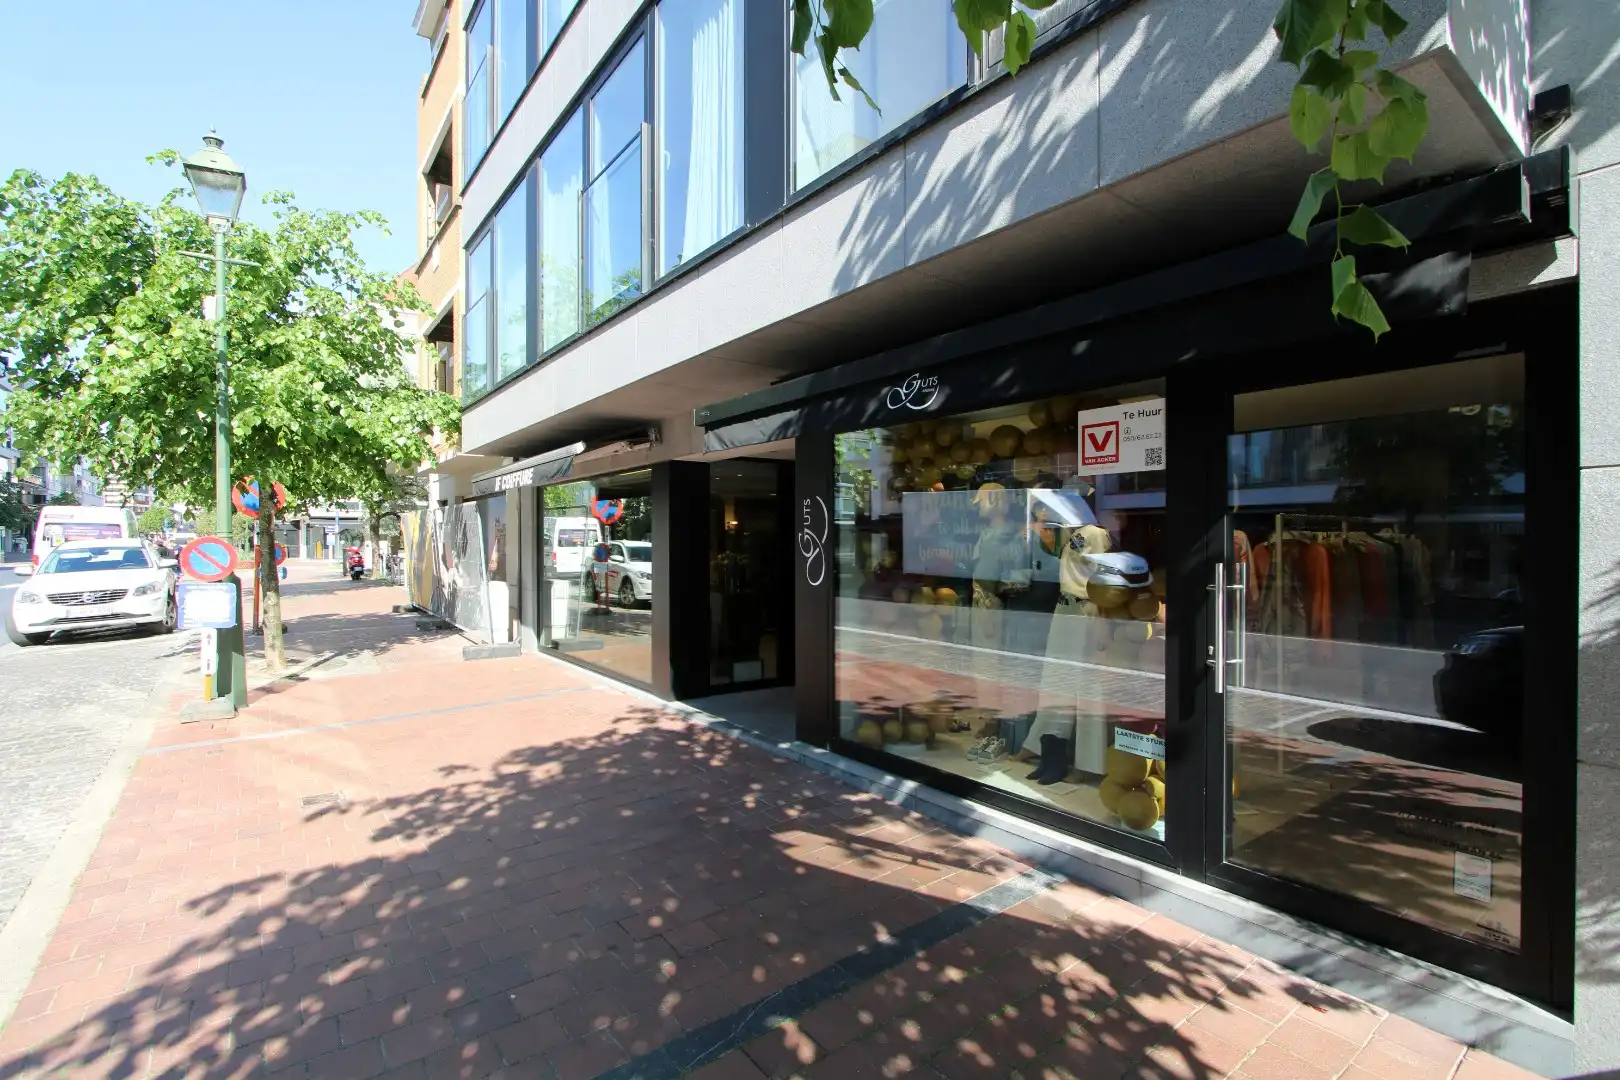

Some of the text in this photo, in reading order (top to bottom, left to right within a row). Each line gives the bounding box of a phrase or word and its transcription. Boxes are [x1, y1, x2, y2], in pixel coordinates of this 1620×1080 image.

[1123, 408, 1162, 420] Te Huur
[1116, 730, 1145, 741] LAATSTE
